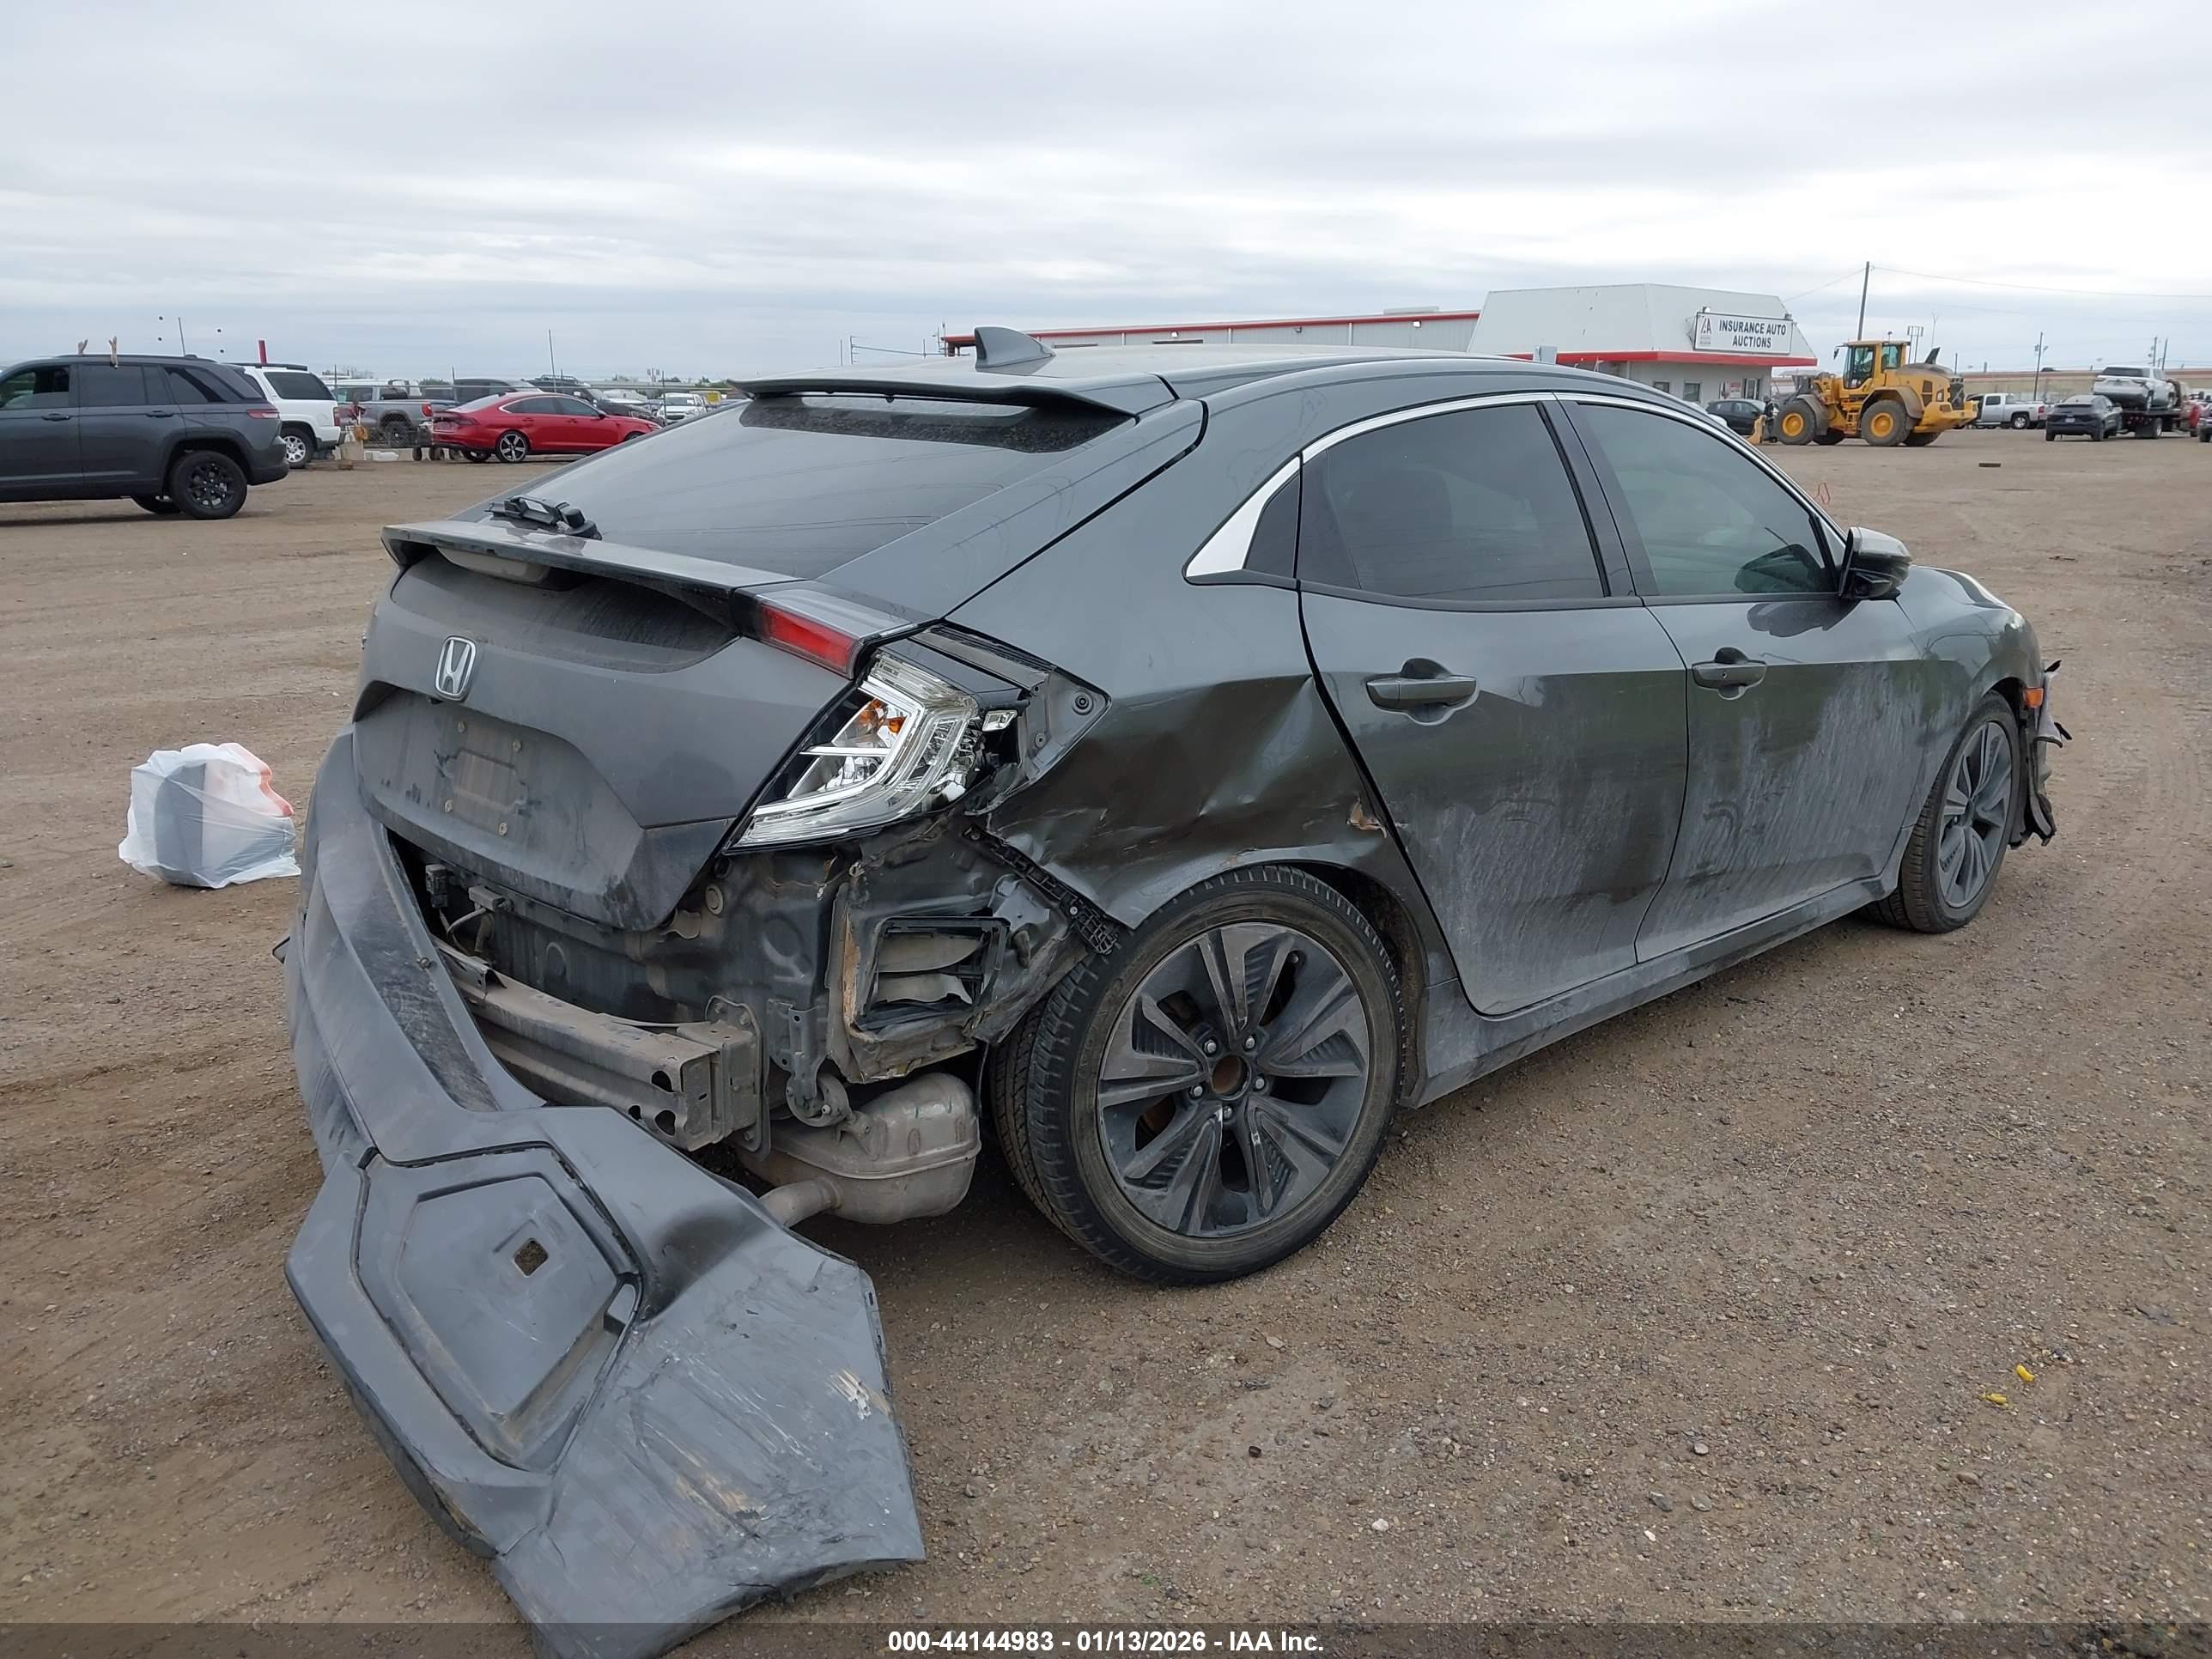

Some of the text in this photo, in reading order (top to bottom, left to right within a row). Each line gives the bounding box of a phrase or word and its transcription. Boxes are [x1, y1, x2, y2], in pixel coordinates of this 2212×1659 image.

[1719, 319, 1787, 336] INSURANCE AUTO
[1732, 336, 1771, 348] AUCTIONS
